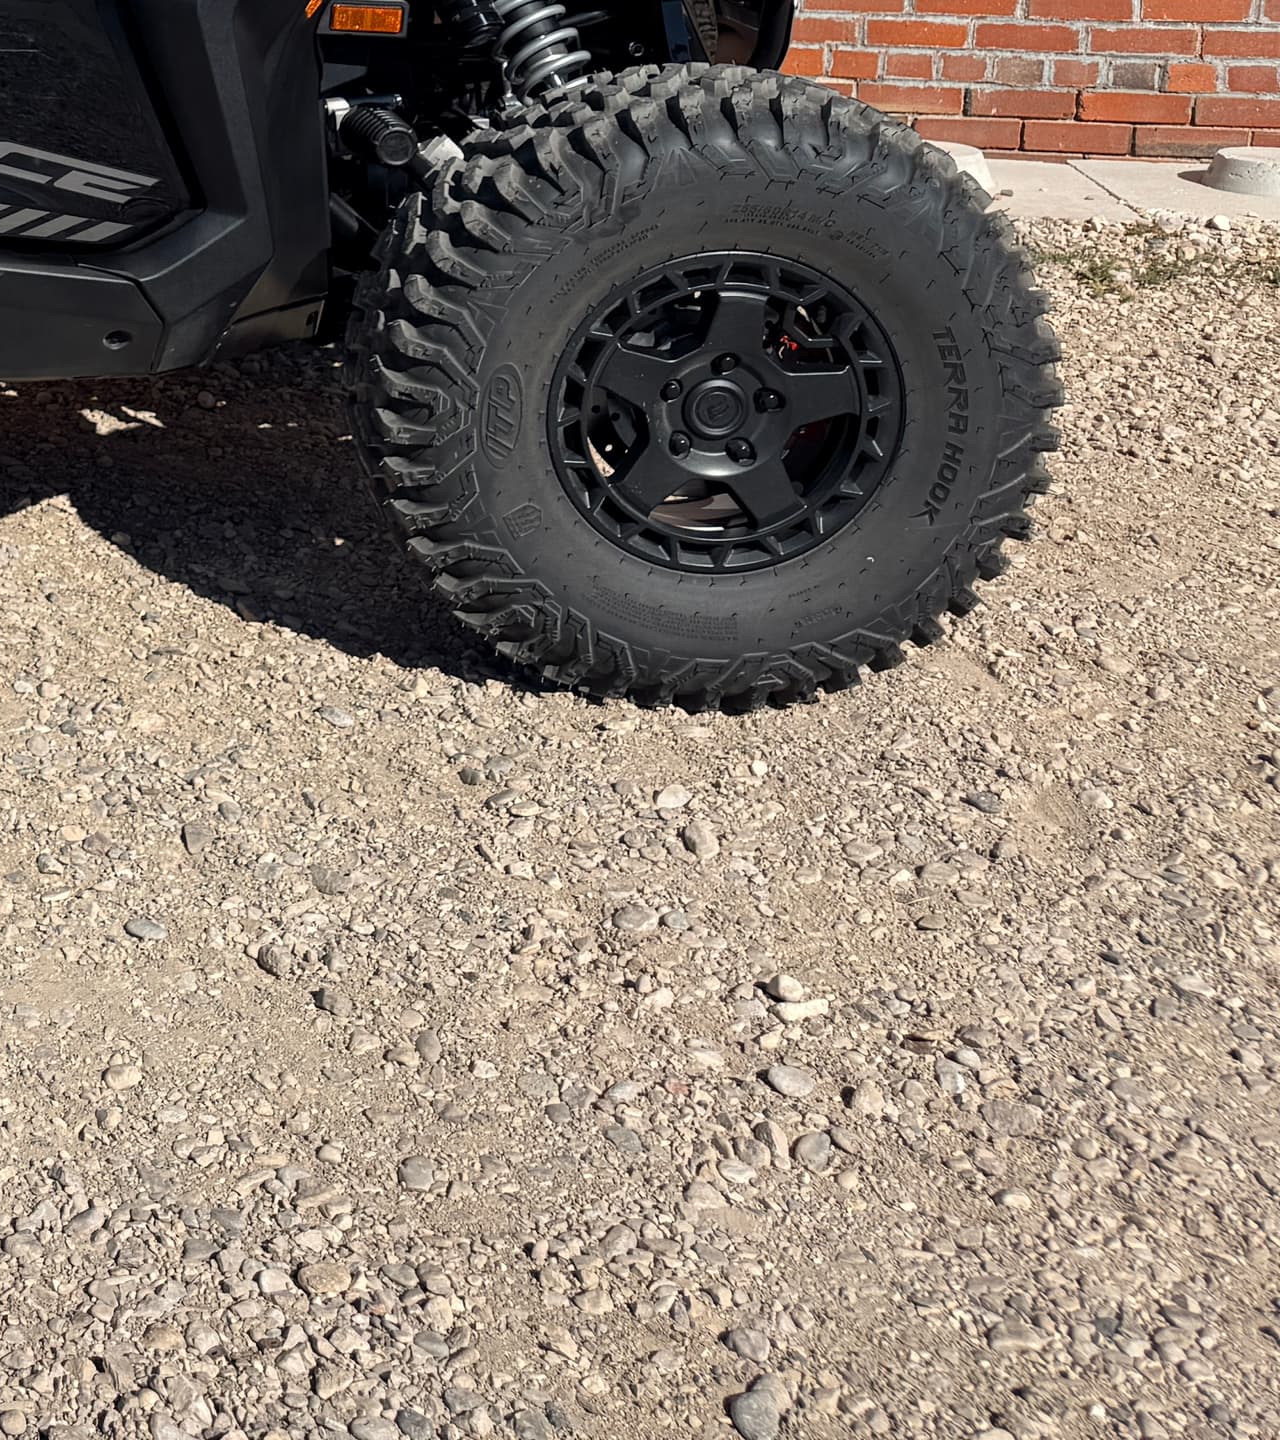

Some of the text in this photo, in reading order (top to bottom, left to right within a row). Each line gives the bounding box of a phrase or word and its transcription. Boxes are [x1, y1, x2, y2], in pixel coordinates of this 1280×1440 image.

[485, 373, 517, 460] ITP
[907, 325, 969, 527] TERRA HOOK
